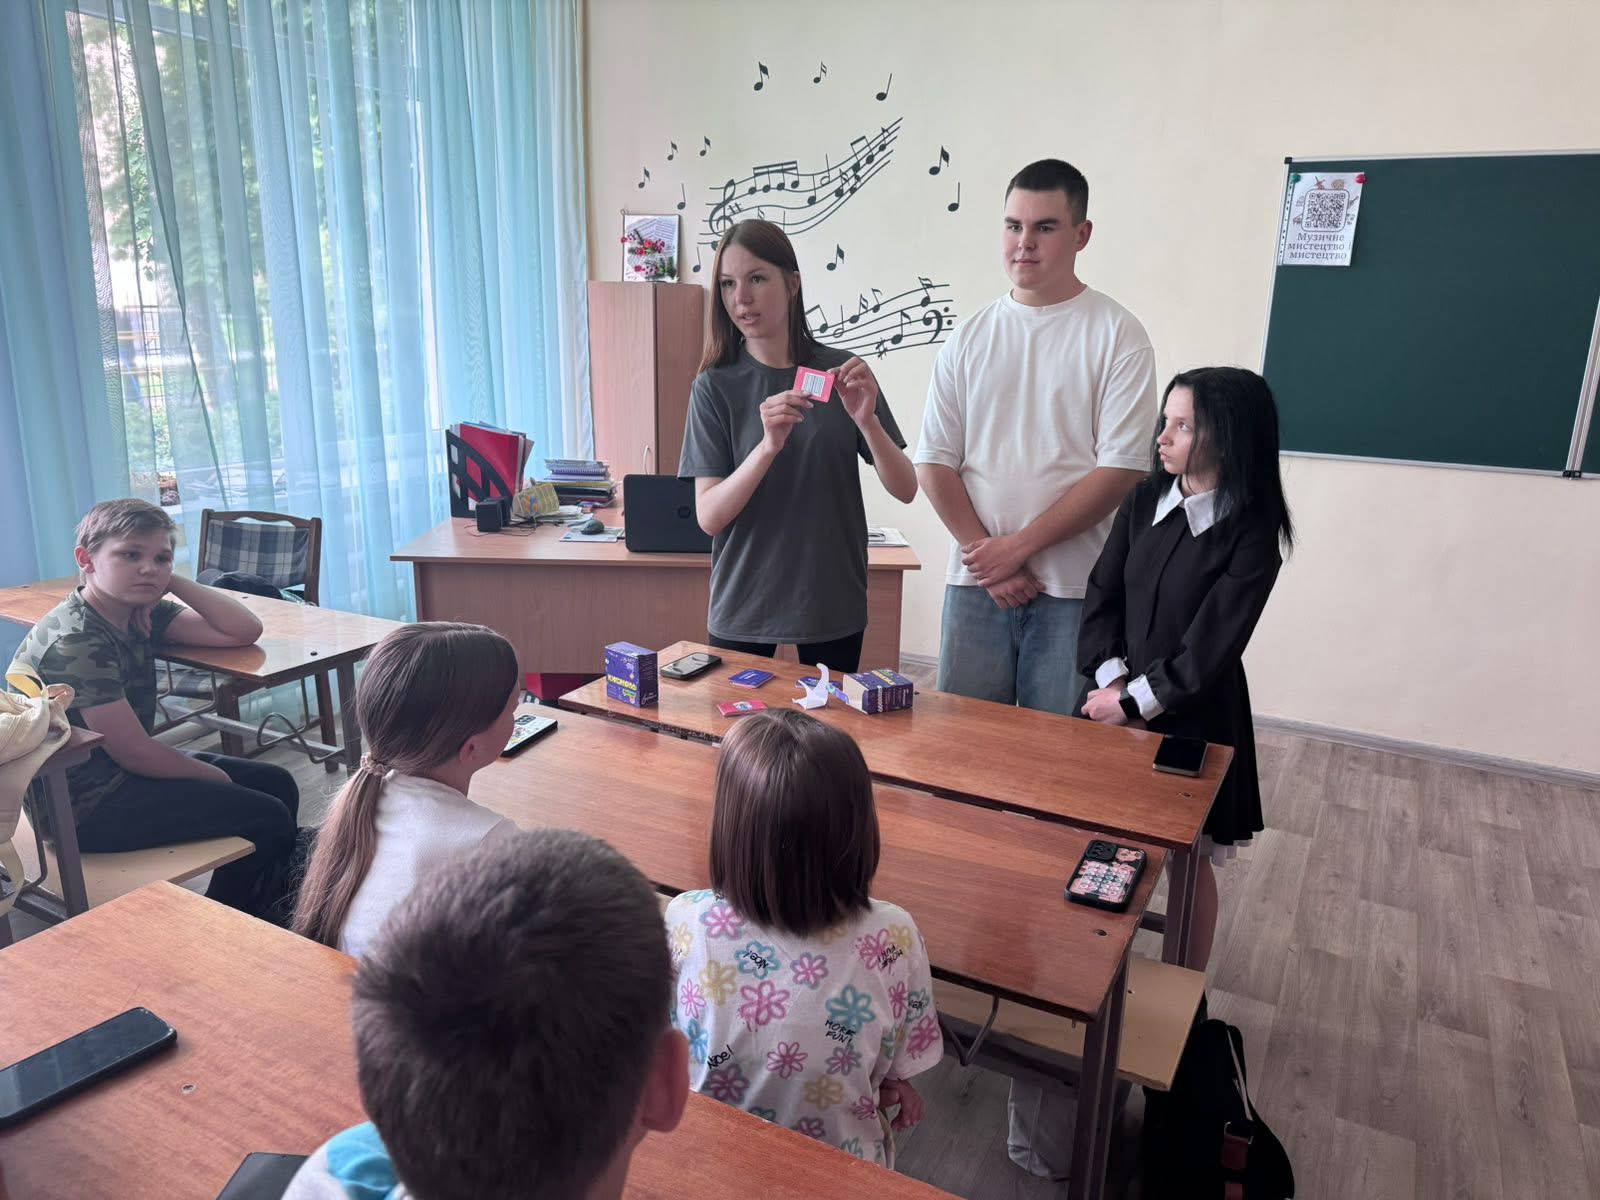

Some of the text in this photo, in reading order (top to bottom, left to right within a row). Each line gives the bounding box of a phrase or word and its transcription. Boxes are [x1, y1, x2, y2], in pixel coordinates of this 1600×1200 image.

[1297, 232, 1345, 243] Музичне
[1287, 242, 1345, 251] мистецтво
[1289, 251, 1347, 260] мистецтво
